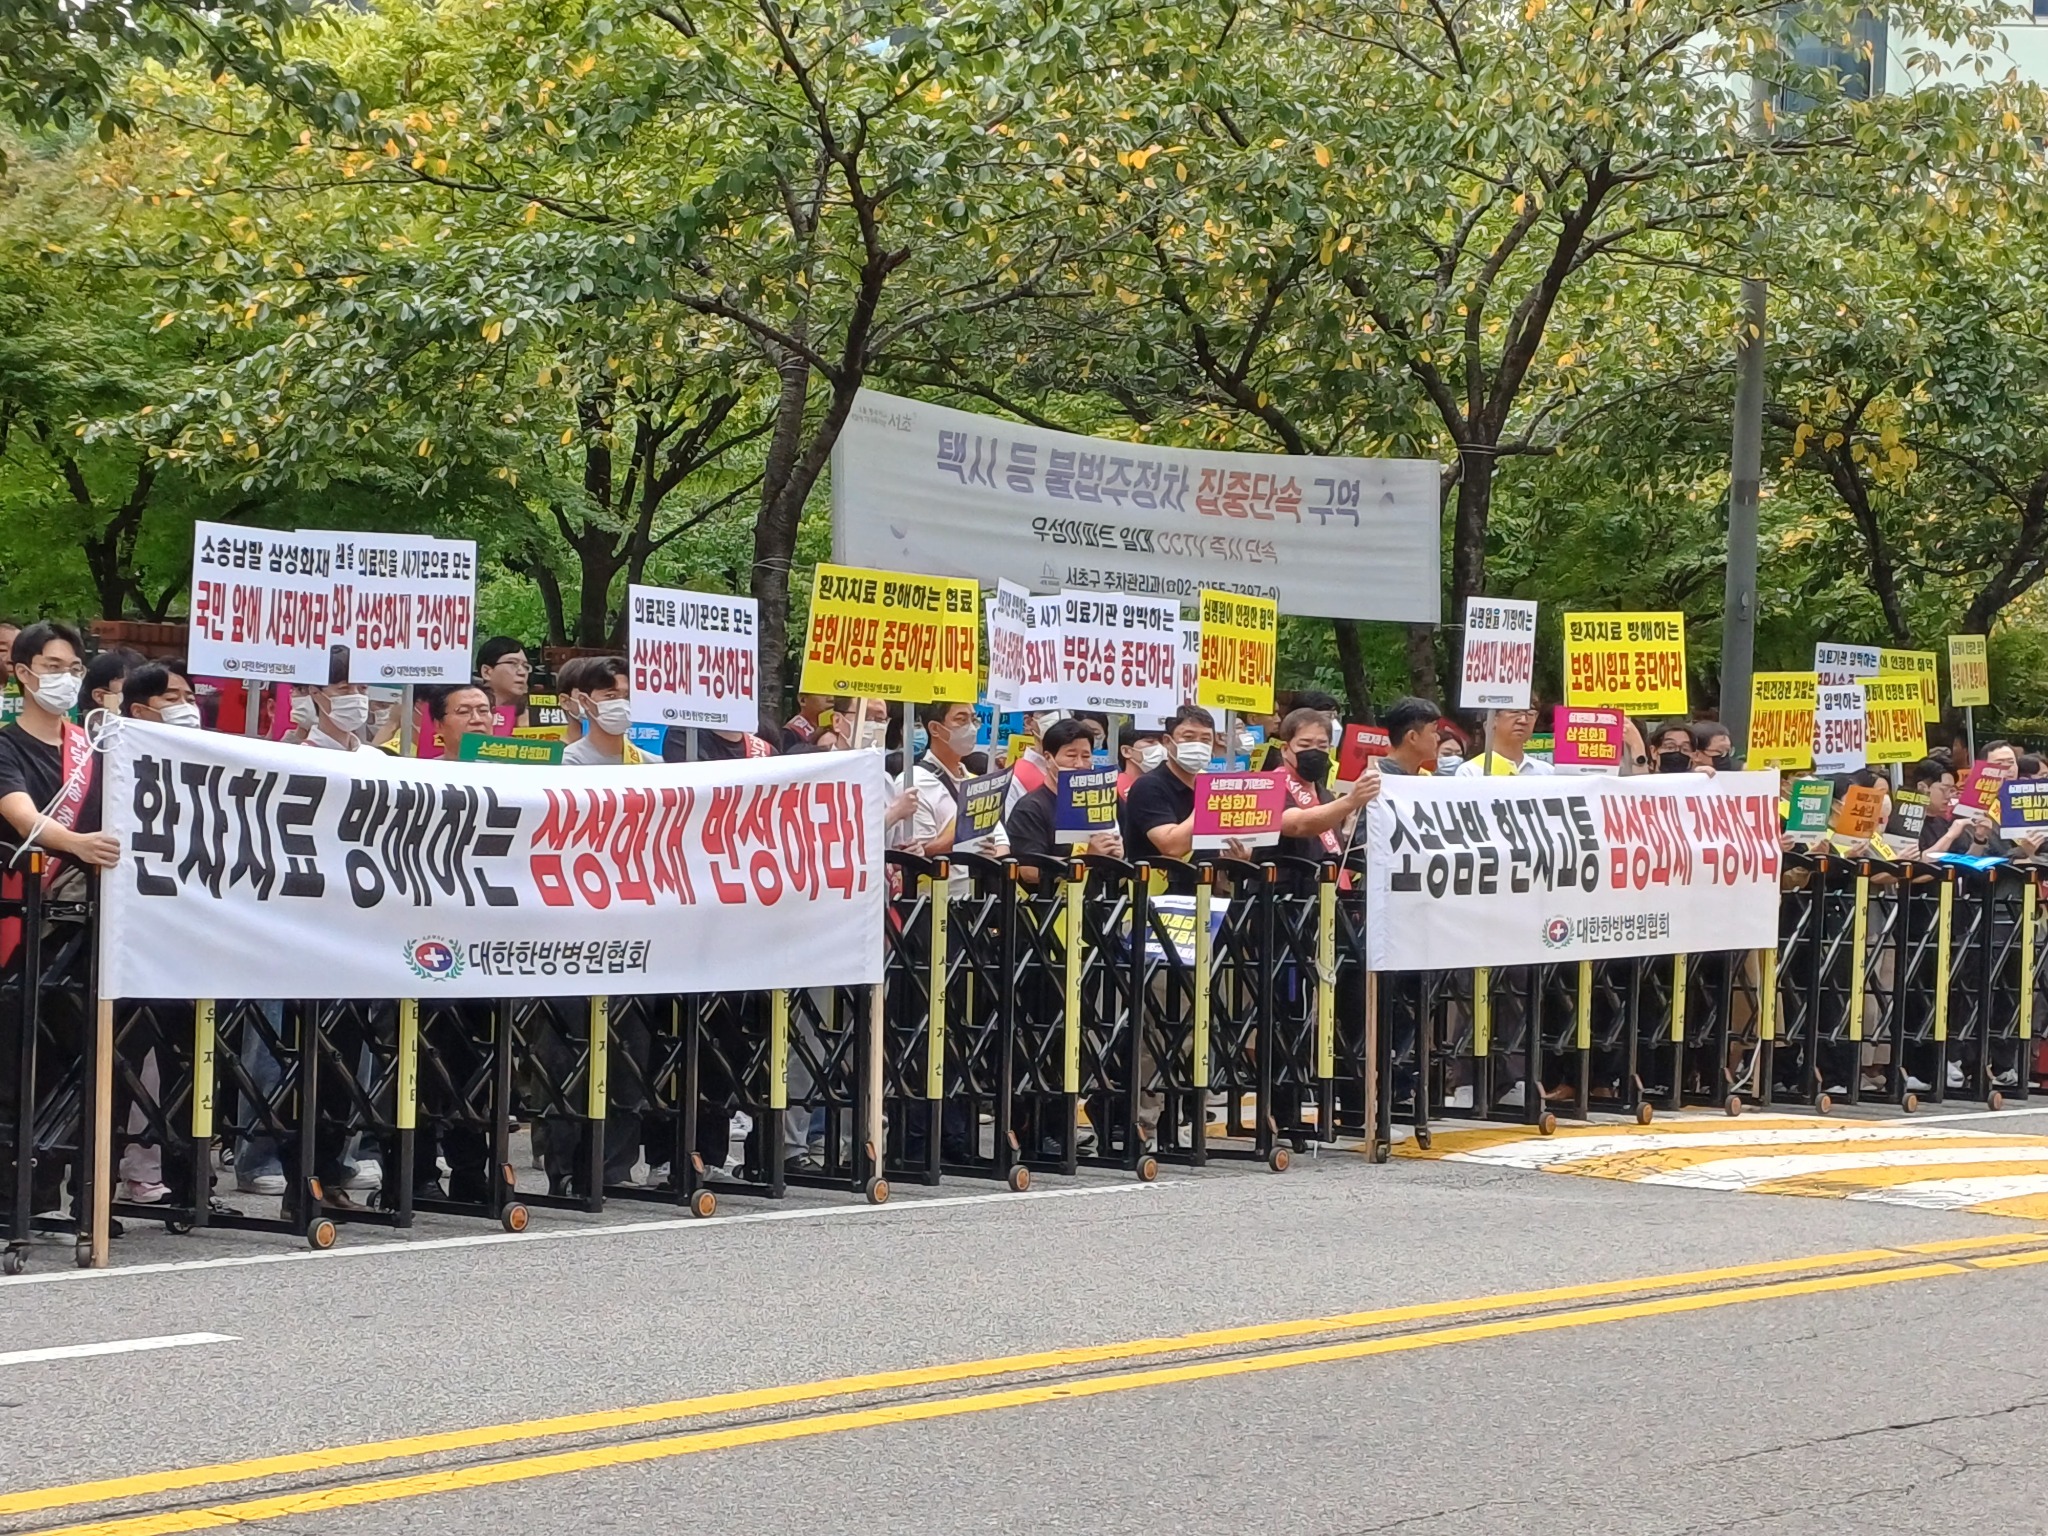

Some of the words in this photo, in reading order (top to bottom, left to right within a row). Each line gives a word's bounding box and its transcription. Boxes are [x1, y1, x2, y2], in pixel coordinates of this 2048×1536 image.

[937, 430, 998, 489] 택시
[1006, 442, 1038, 493] 등
[1045, 447, 1189, 512] 불법주정차
[1195, 468, 1302, 524] 집중단속
[1307, 478, 1361, 527] 구역
[201, 535, 263, 571] 소송남발
[268, 543, 331, 578] 삼성화재
[1119, 527, 1154, 554] 일대
[1156, 532, 1207, 558] CCTV
[358, 549, 398, 578] 의료진을
[401, 551, 450, 579] 사기꾼으로
[452, 552, 471, 580] 모는
[1066, 566, 1101, 588] 서초구
[819, 575, 876, 605] 환자치료
[883, 581, 941, 612] 방해하는
[196, 580, 227, 641] 국민
[231, 583, 263, 645] 앞에
[266, 588, 329, 651] 사죄하라
[356, 592, 411, 651] 삼성화재
[416, 594, 471, 651] 각성하라
[634, 596, 676, 628] 의료진을
[679, 602, 730, 633] 사기꾼으로
[733, 607, 753, 636] 모는
[1066, 599, 1117, 625] 의료기관
[1123, 604, 1175, 632] 압박하는
[1570, 620, 1623, 643] 환자치료
[1628, 620, 1680, 642] 방해하는
[808, 612, 880, 668] 보험사횡포
[881, 620, 937, 674] 중단하라
[1063, 635, 1116, 687] 부당소송
[1121, 640, 1175, 689] 중단하라
[1466, 639, 1496, 683] 삼성화재
[633, 637, 692, 695] 삼성화재
[698, 644, 754, 700] 각성하라
[1570, 651, 1631, 692] 보험사횡포
[1634, 651, 1683, 692] 중단하라
[131, 754, 327, 901] 환자치료
[338, 778, 523, 909] 방해하는
[530, 786, 697, 910] 삼성화재
[701, 780, 867, 907] 반성하라!
[1385, 799, 1499, 898] 소송남발
[1491, 795, 1600, 893] 환자고통
[1600, 794, 1693, 891] 삼성화재
[1576, 912, 1670, 944] 대한한방병원협회
[468, 938, 651, 976] 대한한방병원협회
